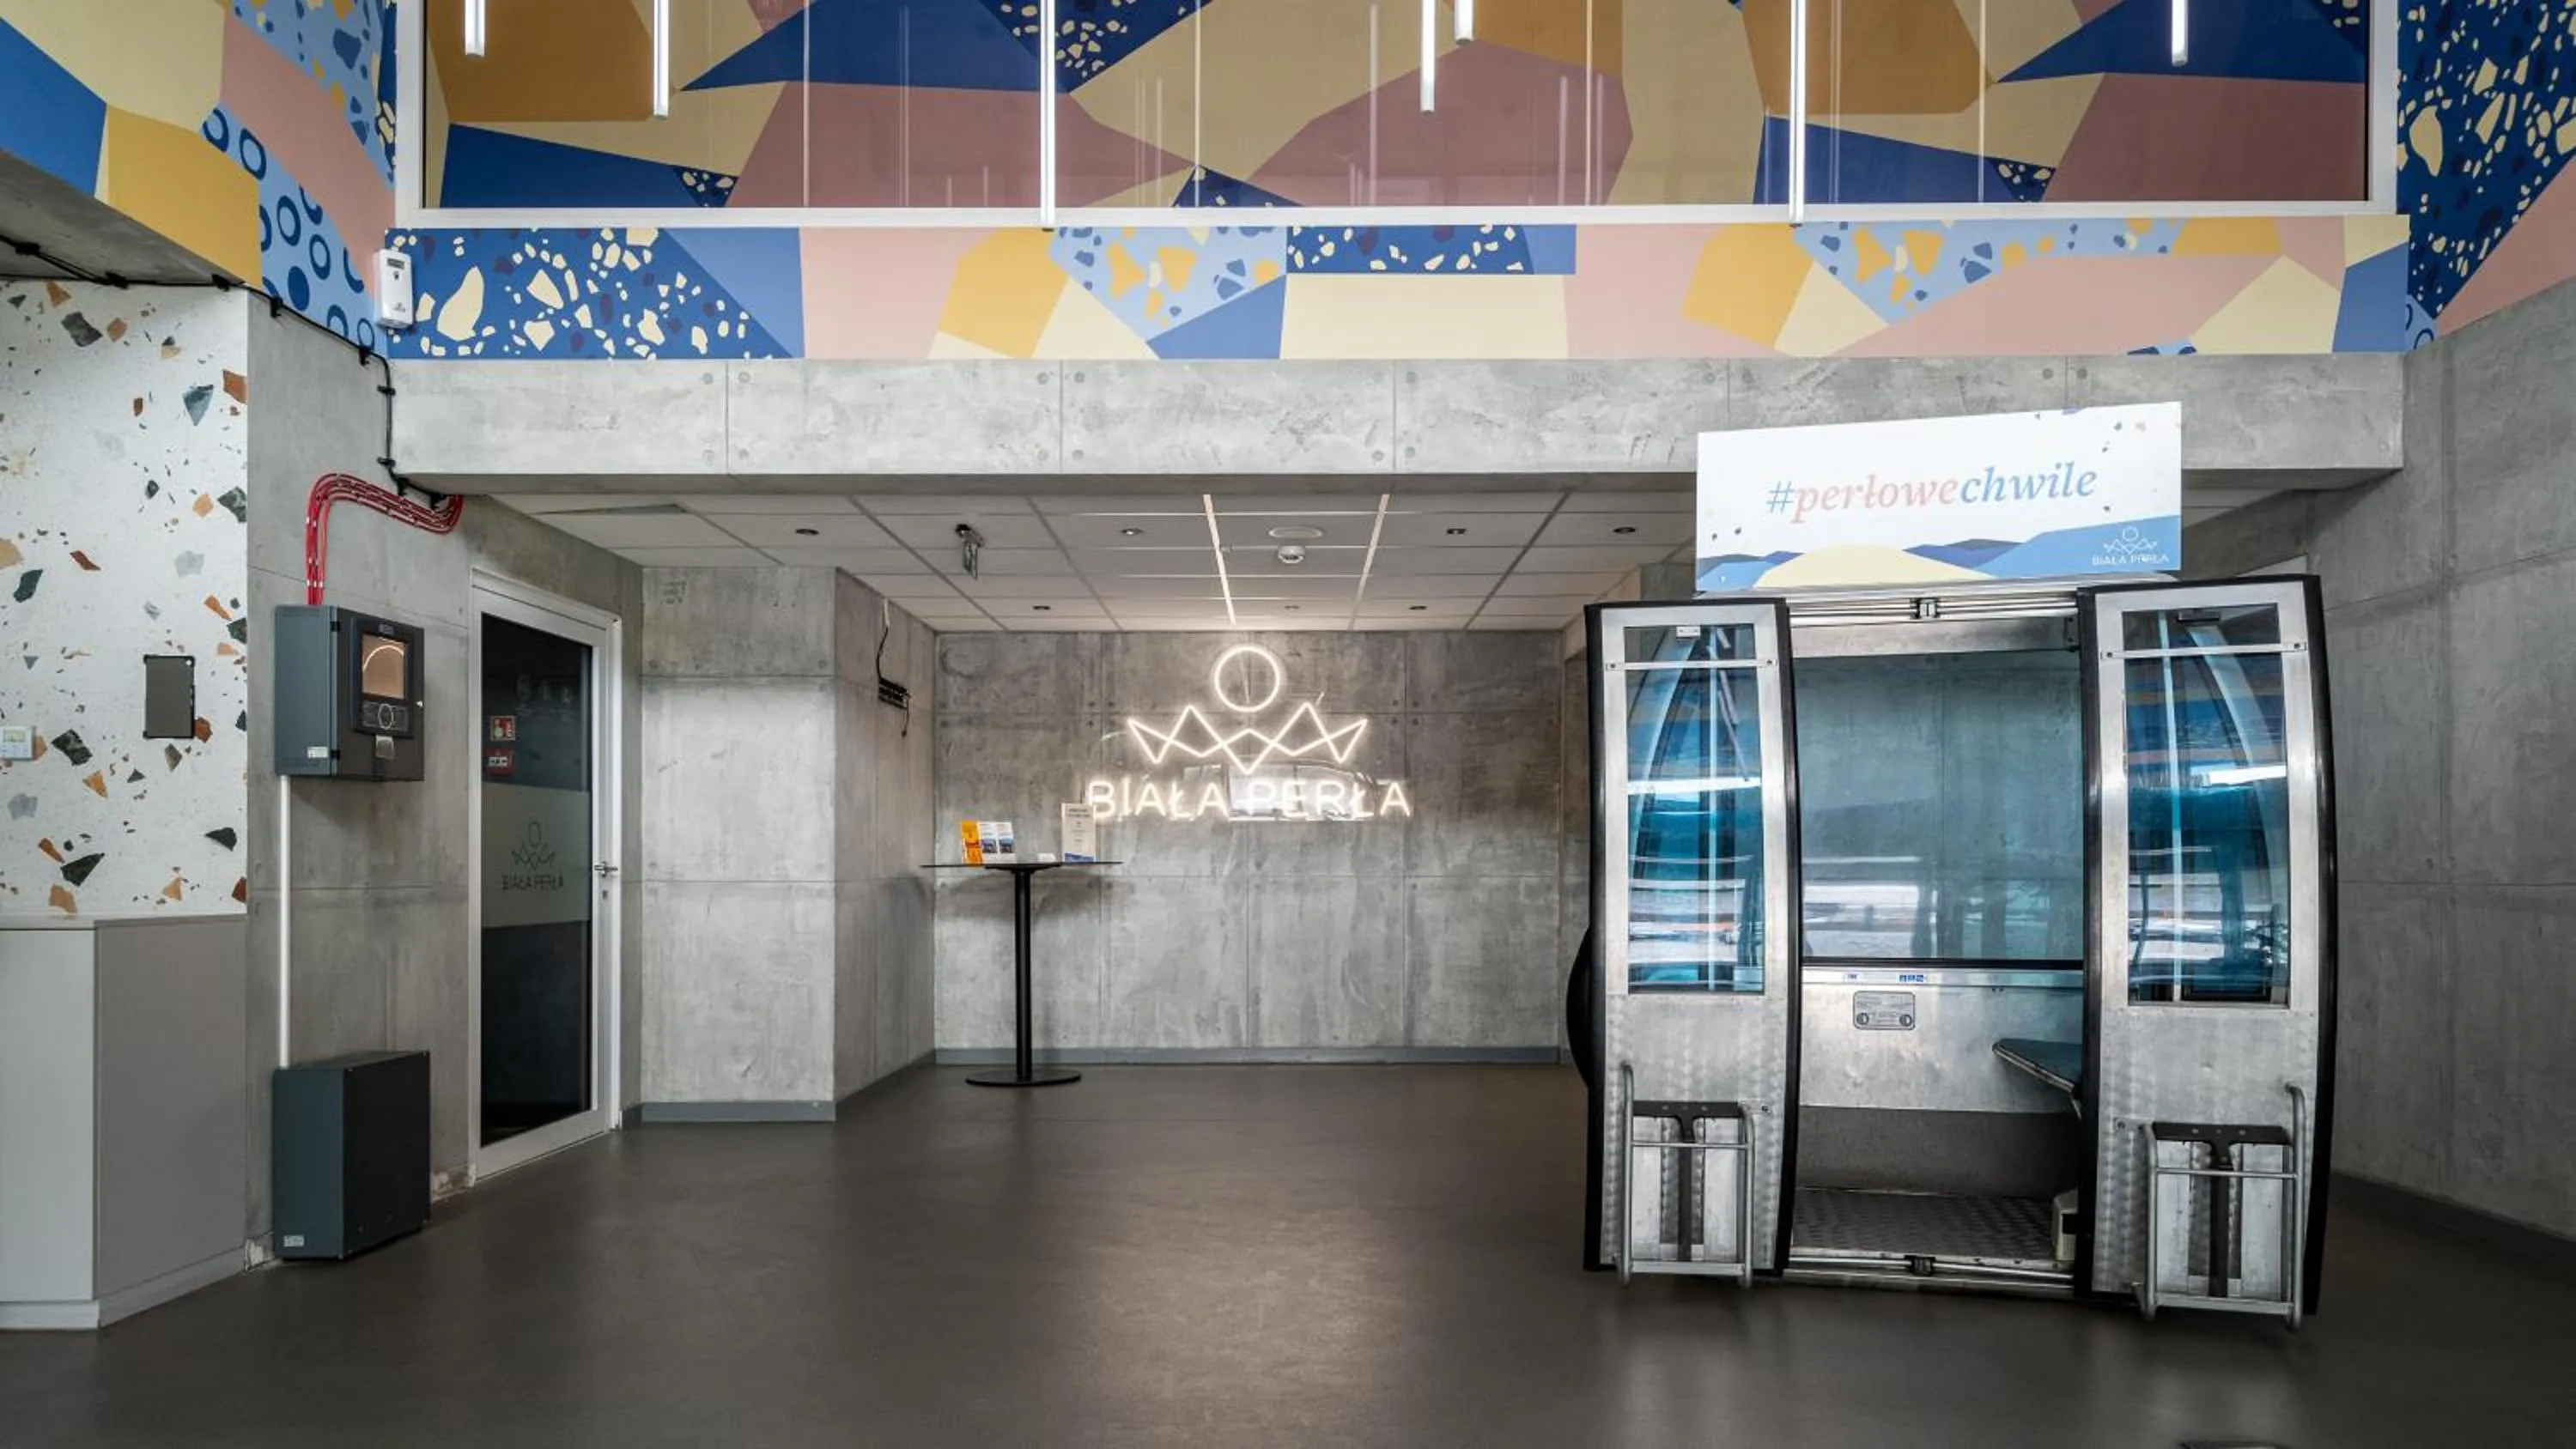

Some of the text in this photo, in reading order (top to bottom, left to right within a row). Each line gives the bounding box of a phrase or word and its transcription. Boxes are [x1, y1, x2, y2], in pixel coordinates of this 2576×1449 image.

[1765, 460, 2098, 524] #perłowechwile
[1087, 778, 1411, 818] BIAŁA PERŁA
